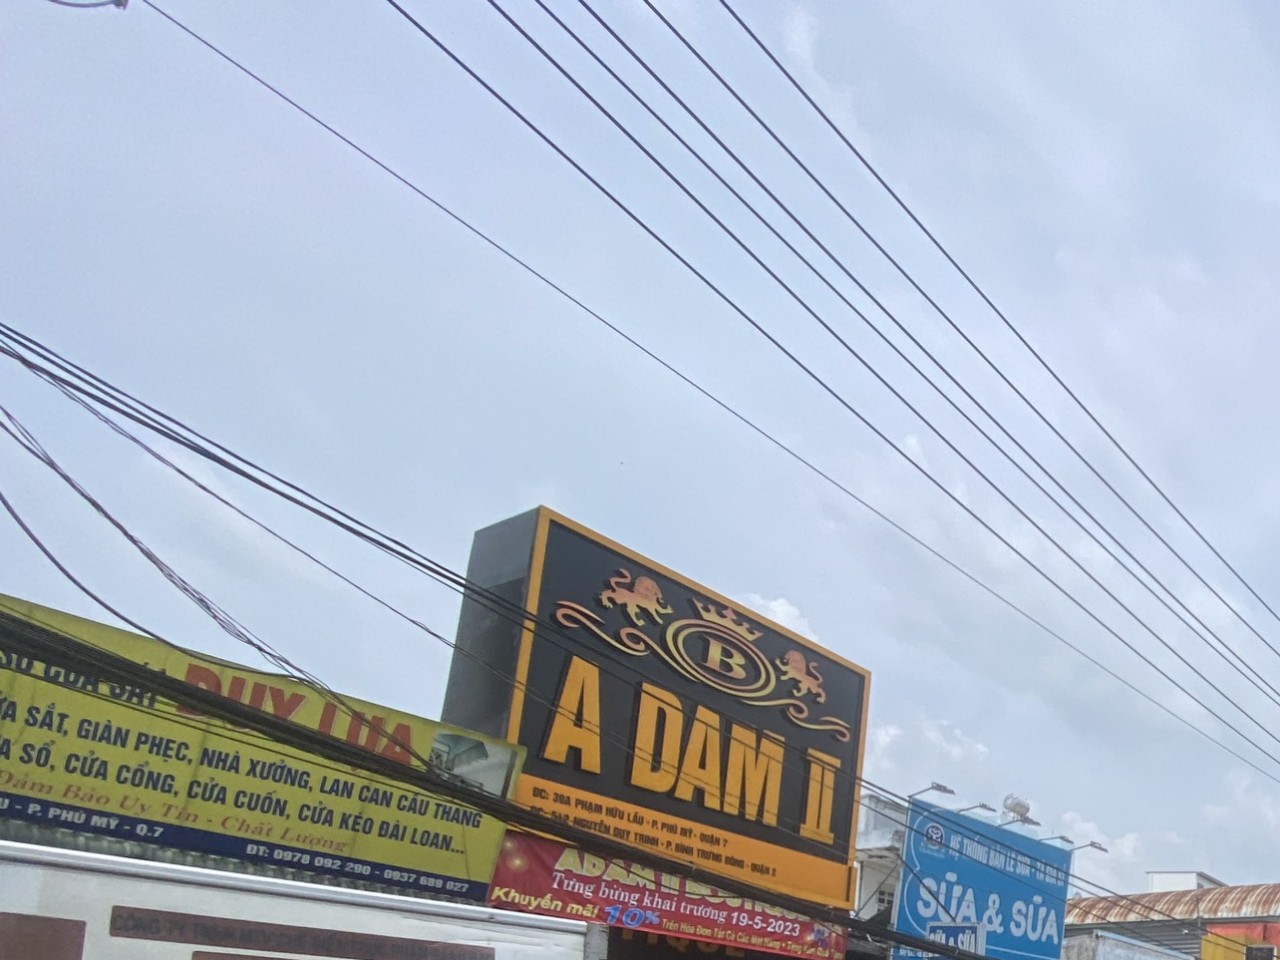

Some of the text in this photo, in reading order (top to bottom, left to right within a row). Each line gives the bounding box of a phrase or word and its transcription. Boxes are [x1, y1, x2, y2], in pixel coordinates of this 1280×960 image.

[704, 633, 747, 681] B
[24, 702, 70, 738] SẮT,
[76, 718, 130, 748] GIÀN
[199, 746, 241, 774] NHÀ
[245, 757, 313, 793] XƯỞNG,
[319, 775, 355, 800] LAN
[358, 784, 394, 808] CAN
[432, 801, 483, 829] THANG
[540, 654, 601, 775] A
[630, 681, 786, 829] DAM
[27, 802, 42, 817] P.
[48, 807, 87, 825] PHÚ
[90, 815, 120, 831] MỸ
[135, 823, 164, 838] Q.7
[64, 749, 108, 781] CỬA
[115, 760, 179, 798] CỔNG,
[186, 776, 228, 806] CỬA
[233, 788, 290, 821] CUỐN,
[297, 799, 334, 828] CỬA
[338, 810, 375, 836] KÉO
[377, 818, 408, 843] ĐÀI
[409, 827, 466, 856] LOAN...
[119, 793, 152, 816] Uy
[555, 848, 656, 891] ADAM
[552, 871, 596, 899] Tưng
[599, 881, 640, 908] bừng
[643, 889, 676, 912] khai
[679, 900, 728, 925] trương
[731, 910, 801, 937] 19-5-2023
[604, 904, 661, 929] 10%
[983, 893, 1004, 934] &
[1010, 895, 1059, 945] SỮA
